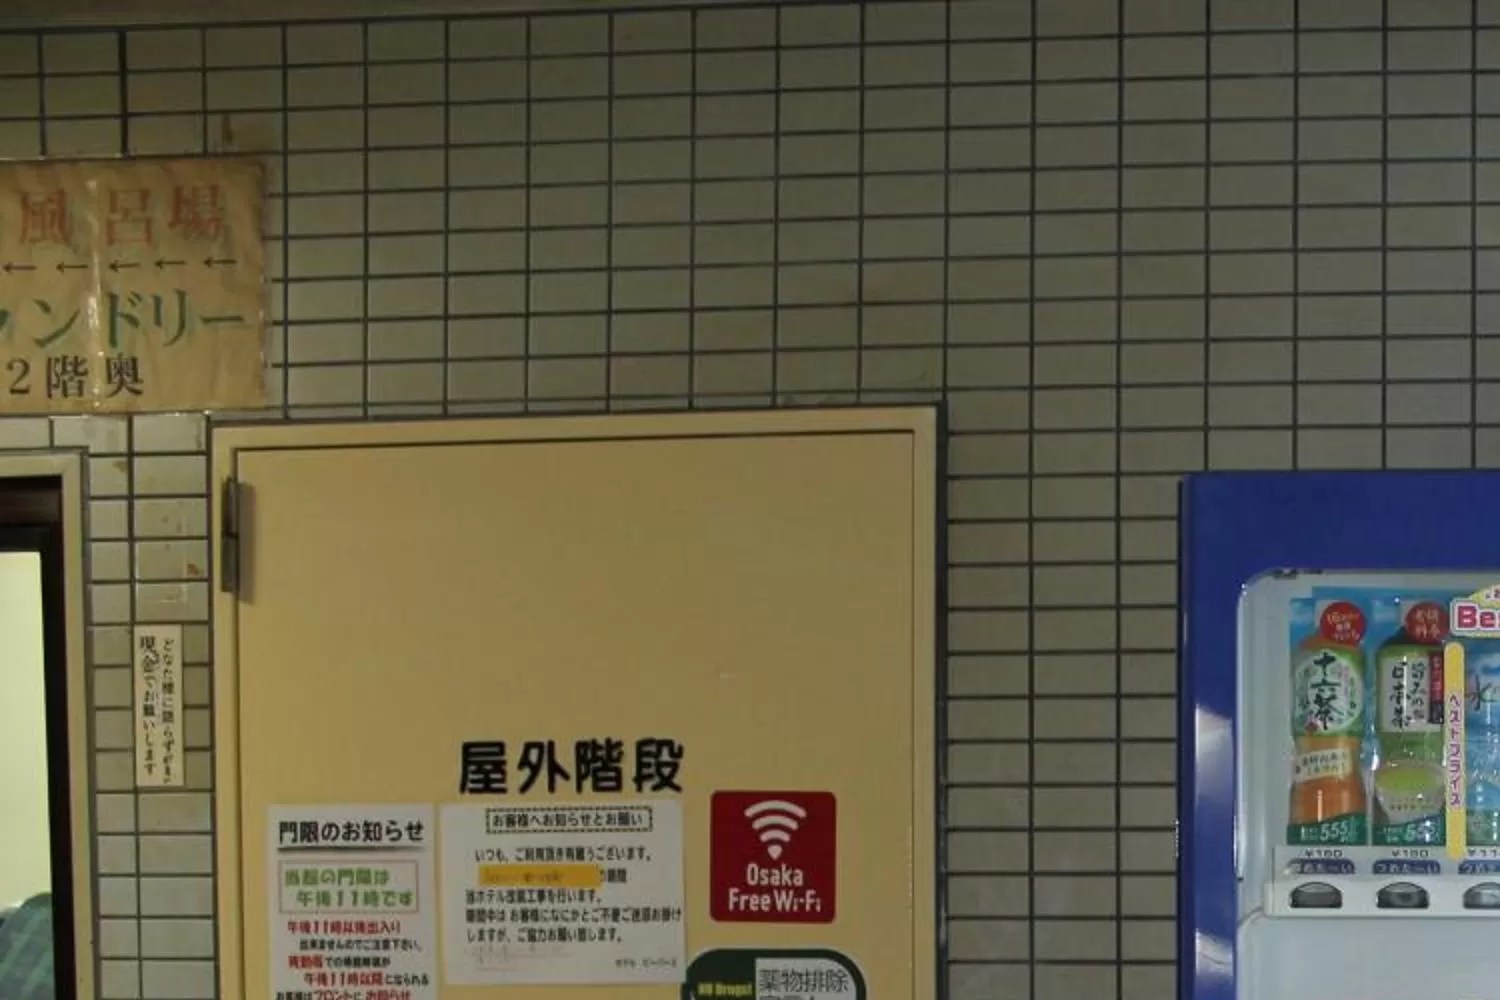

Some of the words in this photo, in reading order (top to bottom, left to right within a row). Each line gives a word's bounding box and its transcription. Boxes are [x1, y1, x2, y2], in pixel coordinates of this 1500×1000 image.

[0, 288, 244, 349] ンドリー
[6, 354, 144, 399] 2階奥
[1310, 651, 1344, 731] 十六茶
[460, 738, 685, 794] 屋外階段
[278, 820, 424, 844] 門限のお知らせ
[492, 812, 643, 828] お客様へお知らせとお願い
[746, 863, 804, 887] Osaka
[728, 888, 771, 911] Free
[774, 890, 822, 912] Wi-Fi
